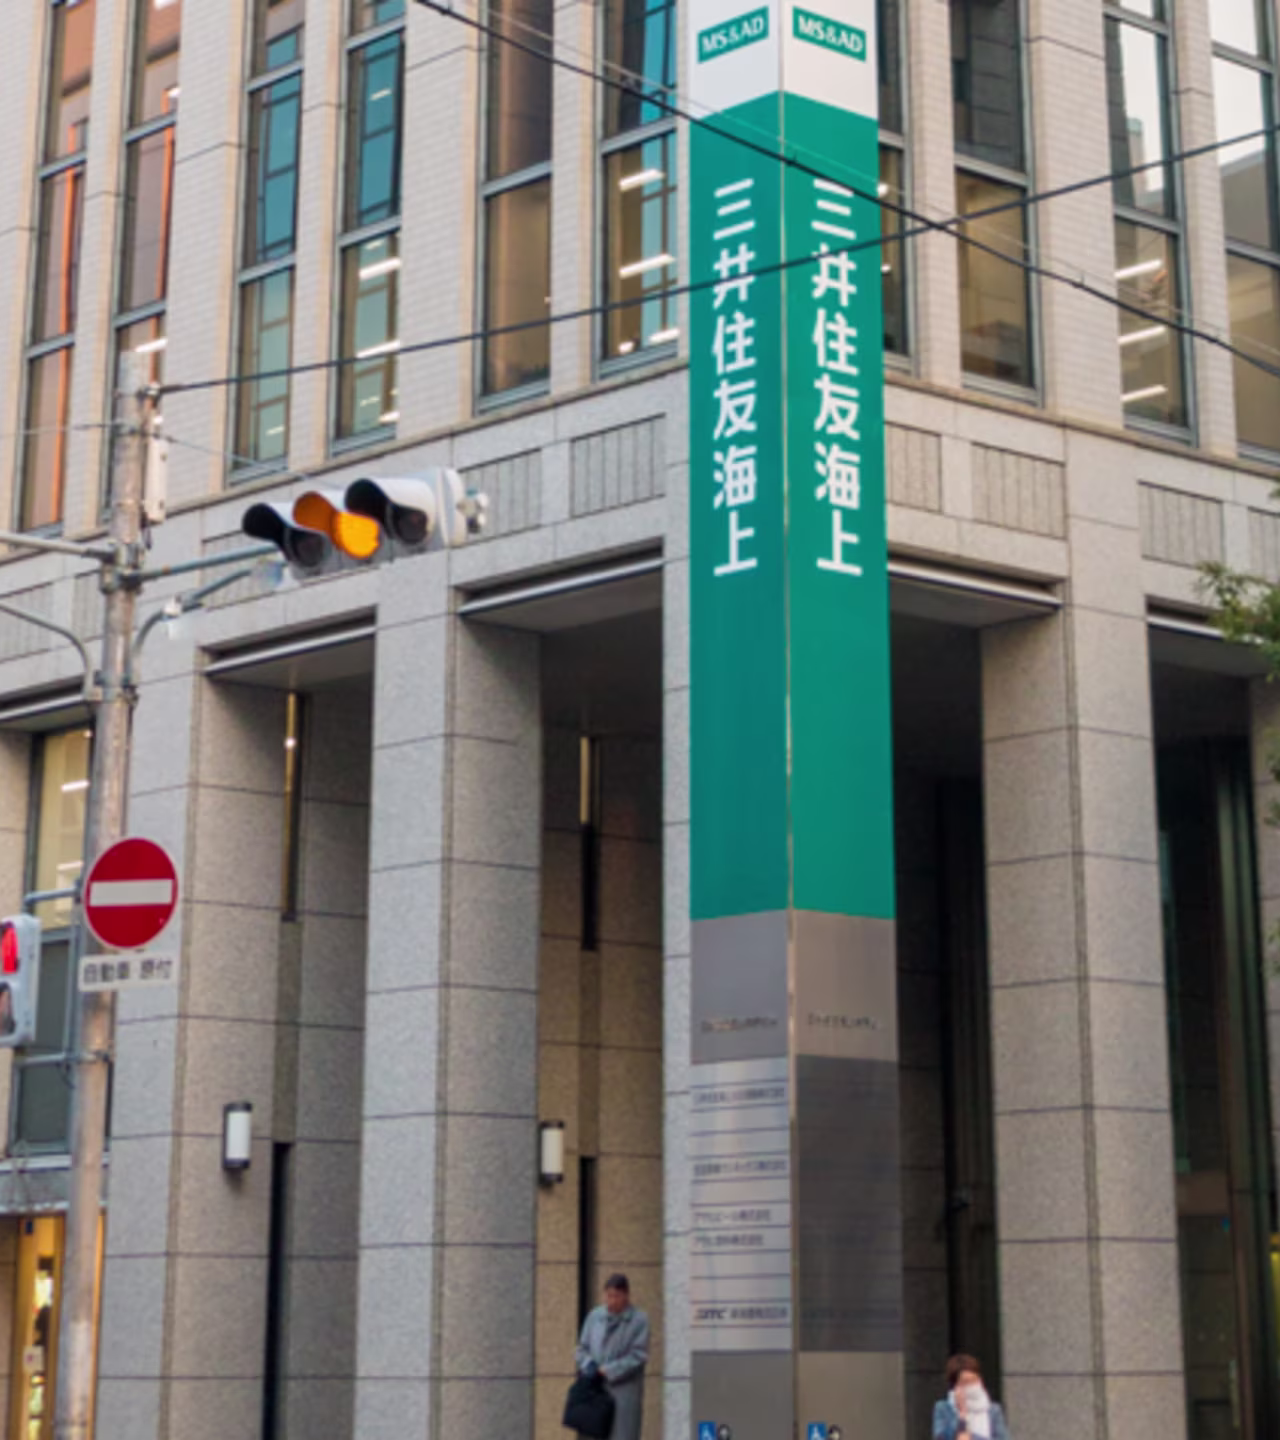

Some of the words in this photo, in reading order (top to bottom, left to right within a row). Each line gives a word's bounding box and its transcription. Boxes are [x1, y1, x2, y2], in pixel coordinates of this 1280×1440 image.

[701, 15, 765, 53] MS&AD
[797, 14, 864, 54] MS&AD
[712, 178, 758, 576] 三井住友海上
[811, 178, 863, 577] 三井住友海上
[83, 961, 131, 985] 自動車
